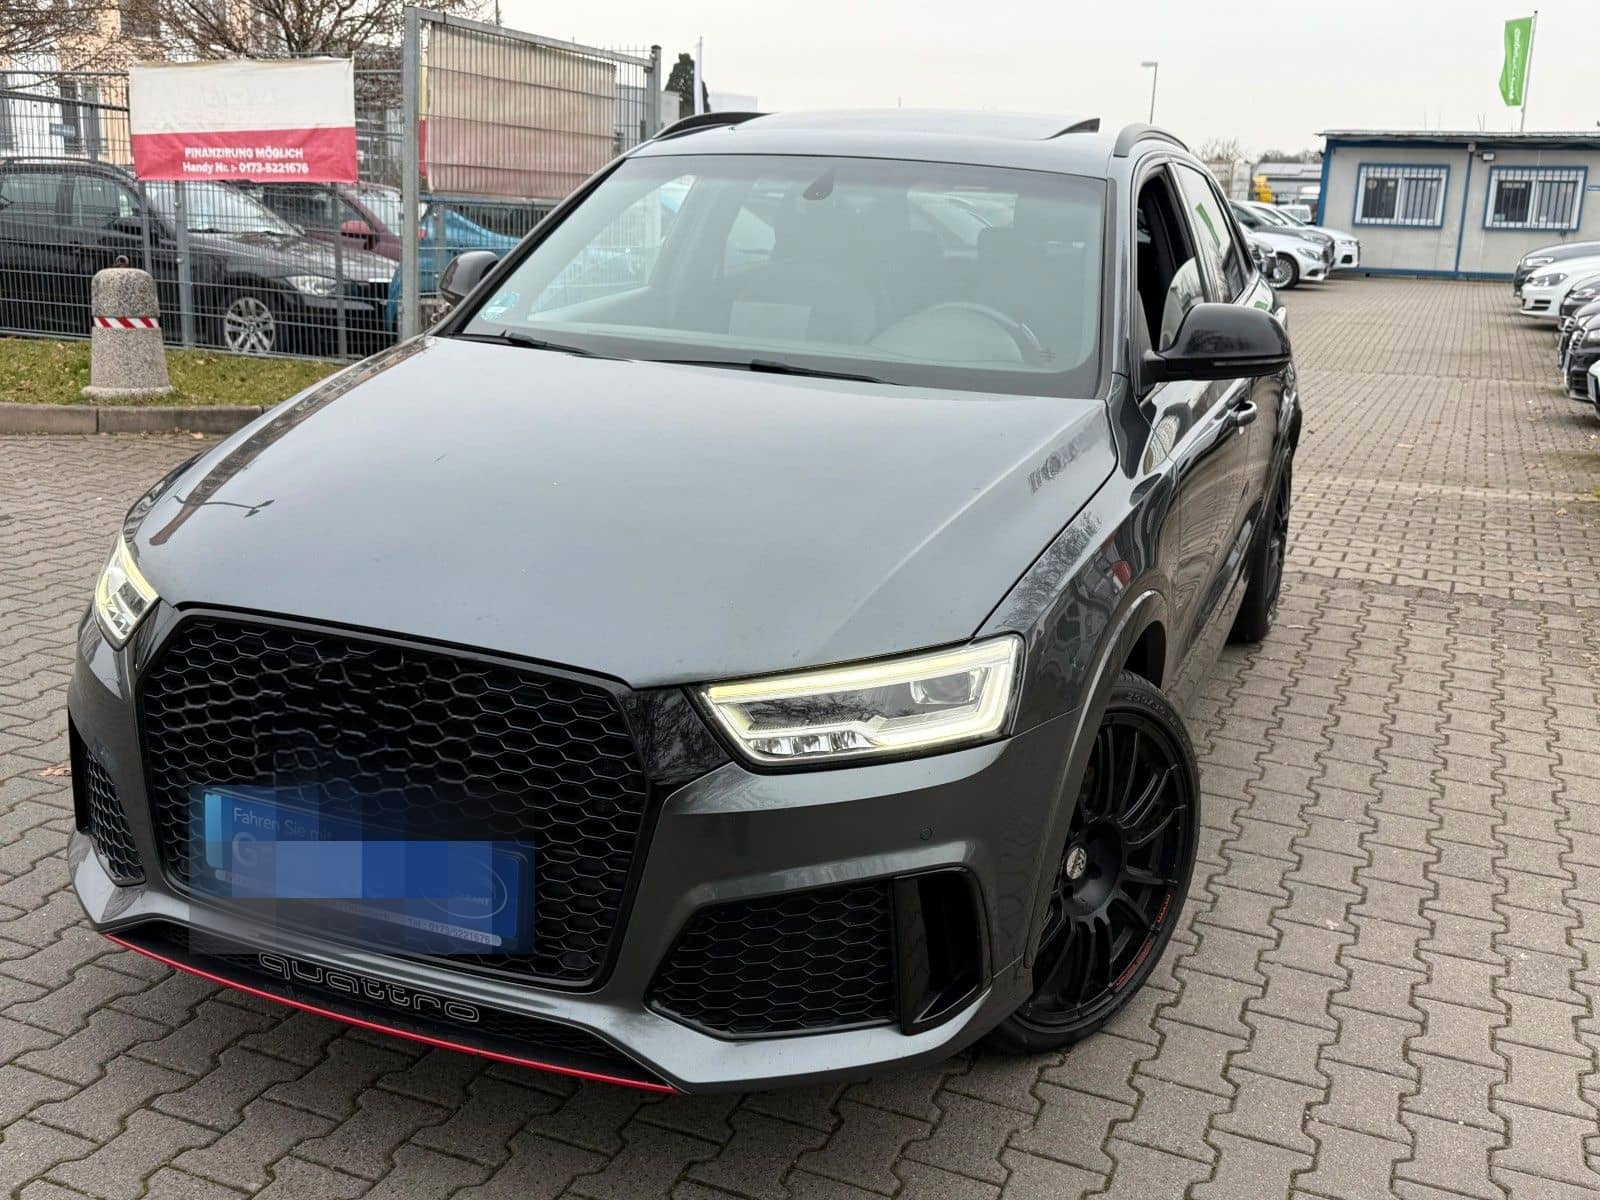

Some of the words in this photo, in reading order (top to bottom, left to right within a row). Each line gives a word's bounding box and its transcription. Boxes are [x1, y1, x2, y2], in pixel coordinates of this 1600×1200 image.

[184, 147, 253, 159] FINANZIRUNG
[255, 145, 304, 159] MÖGLICH
[182, 161, 214, 175] Handy
[239, 162, 309, 174] 0173-5221676
[233, 807, 280, 832] Fahren
[258, 951, 480, 1023] quattro
